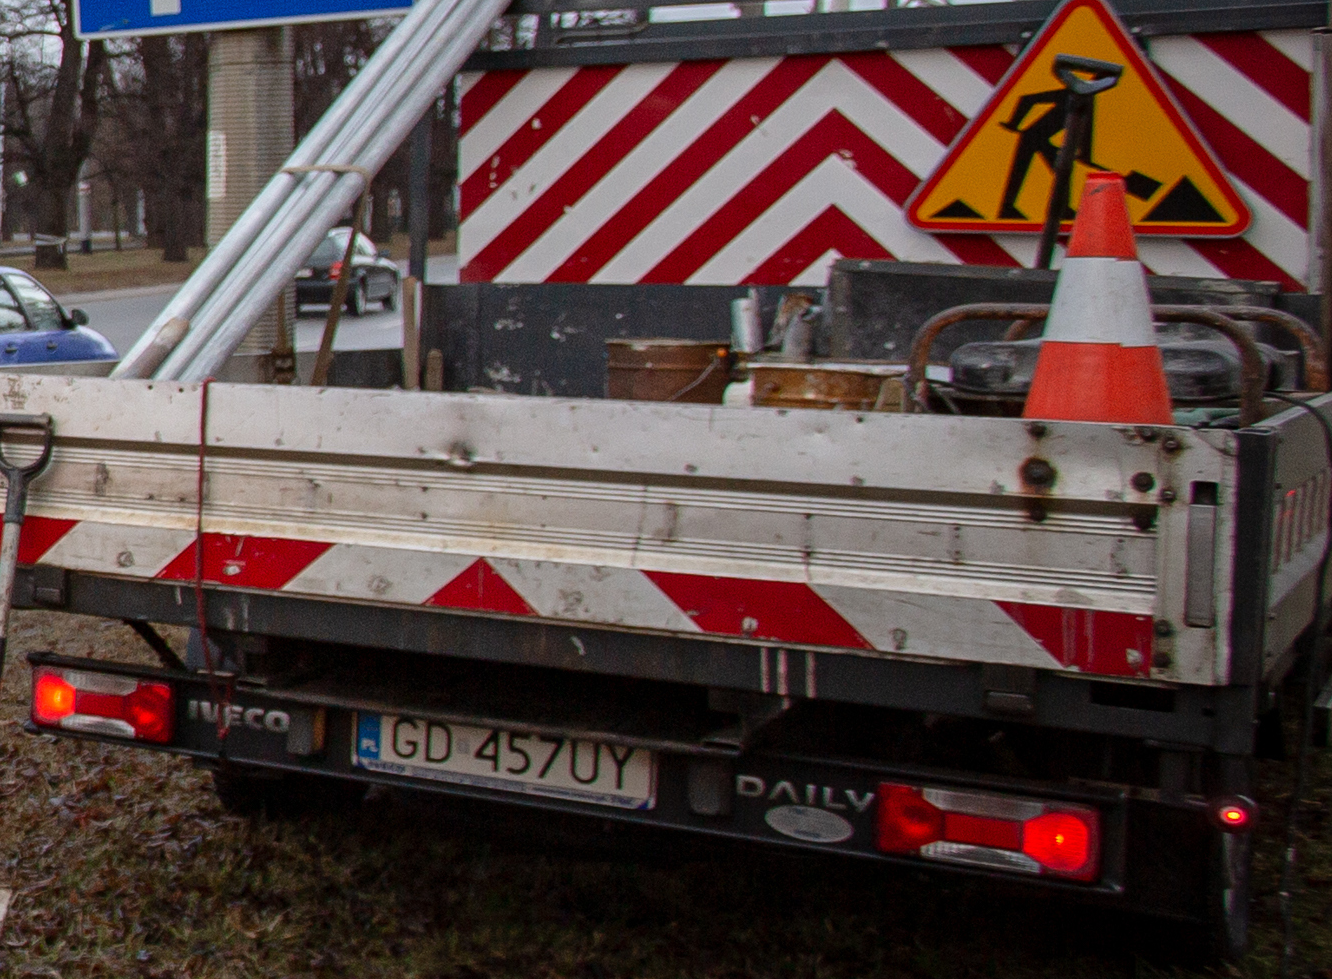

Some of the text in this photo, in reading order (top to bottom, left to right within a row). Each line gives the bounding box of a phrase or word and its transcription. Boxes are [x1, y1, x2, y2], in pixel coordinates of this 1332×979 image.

[188, 700, 291, 733] IVECO
[392, 717, 454, 764] GD
[474, 730, 636, 790] 457UY
